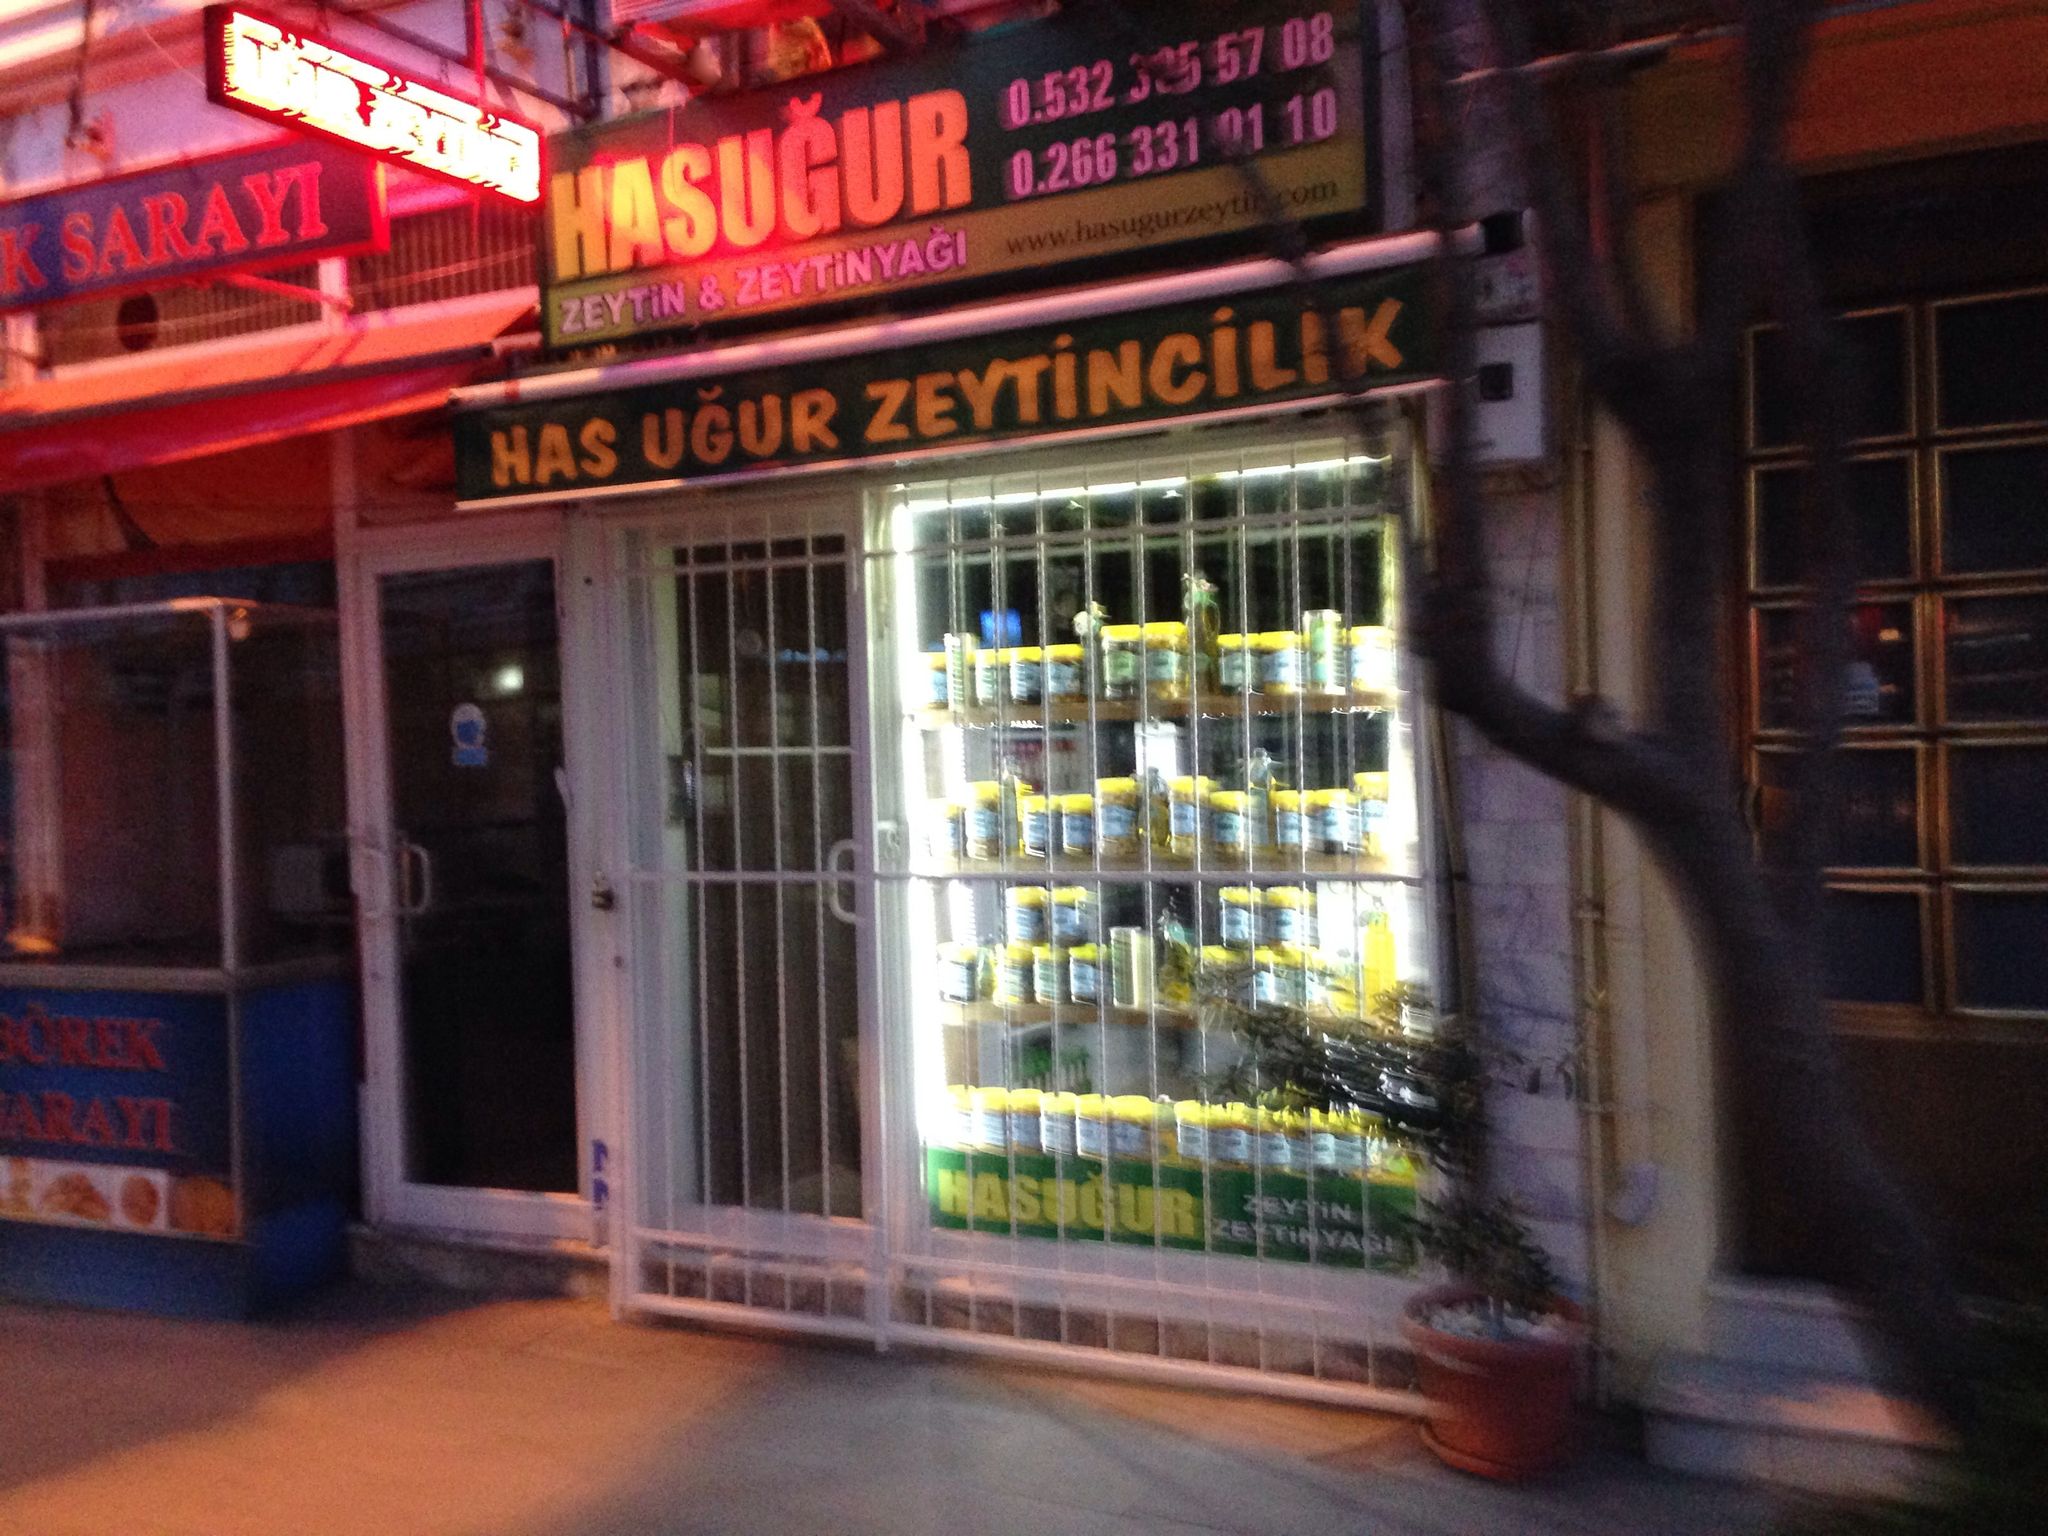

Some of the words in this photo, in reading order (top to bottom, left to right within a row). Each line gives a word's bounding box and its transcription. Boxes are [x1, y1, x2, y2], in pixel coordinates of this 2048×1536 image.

[1003, 59, 1115, 129] 0.532
[1213, 27, 1265, 85] 57
[1281, 12, 1334, 70] 08
[551, 89, 972, 281] HASUĞUR
[1006, 132, 1117, 198] 0.266
[1129, 117, 1199, 177] 331
[1286, 87, 1337, 145] 10
[61, 161, 329, 286] SARAYI
[1005, 178, 1338, 255] www.hasugurzeyticom
[699, 274, 726, 312] &
[490, 417, 619, 488] HAS
[642, 385, 839, 470] UĞUR
[0, 1091, 174, 1152] ARAYI
[936, 1166, 1196, 1237] HASUĞUR
